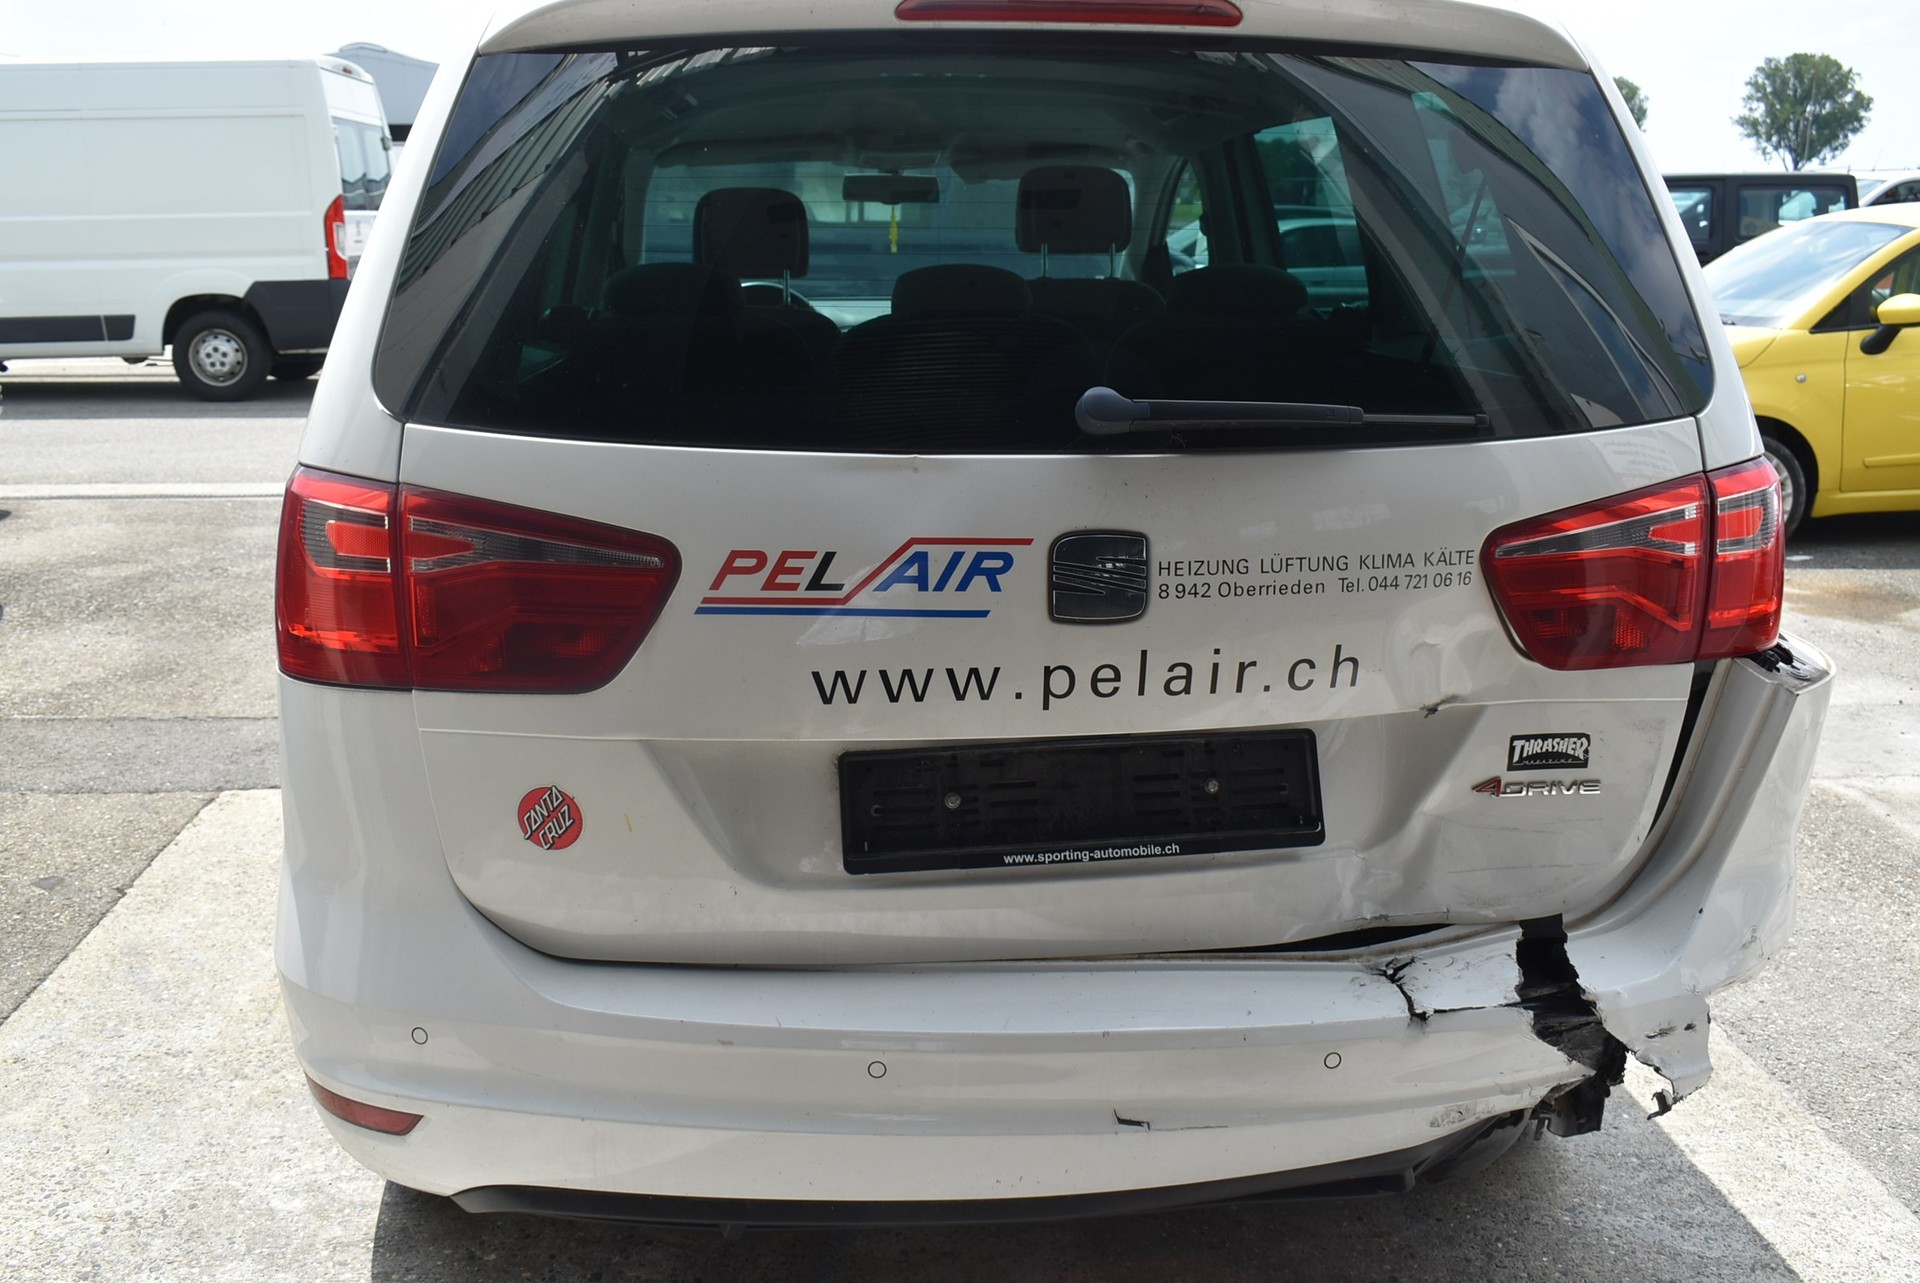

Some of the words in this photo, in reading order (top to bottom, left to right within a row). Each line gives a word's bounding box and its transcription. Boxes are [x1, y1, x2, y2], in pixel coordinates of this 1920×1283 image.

[708, 549, 845, 592] PEL
[871, 550, 1015, 593] AIR
[1158, 557, 1250, 577] HEIZUNG
[1260, 552, 1349, 575] LÜFTUNG
[1359, 552, 1416, 571] KLIMA
[1423, 546, 1475, 568] KÄLTE
[1217, 578, 1325, 599] Oberrieden
[1404, 573, 1428, 590] 721
[810, 644, 1360, 711] www.pelair.ch
[1512, 736, 1589, 763] THRASHER
[1471, 775, 1602, 798] 4DRIVE
[523, 785, 564, 839] SANTA
[539, 804, 575, 850] CRUZ
[1002, 842, 1181, 865] www.sporting-automobile.ch
